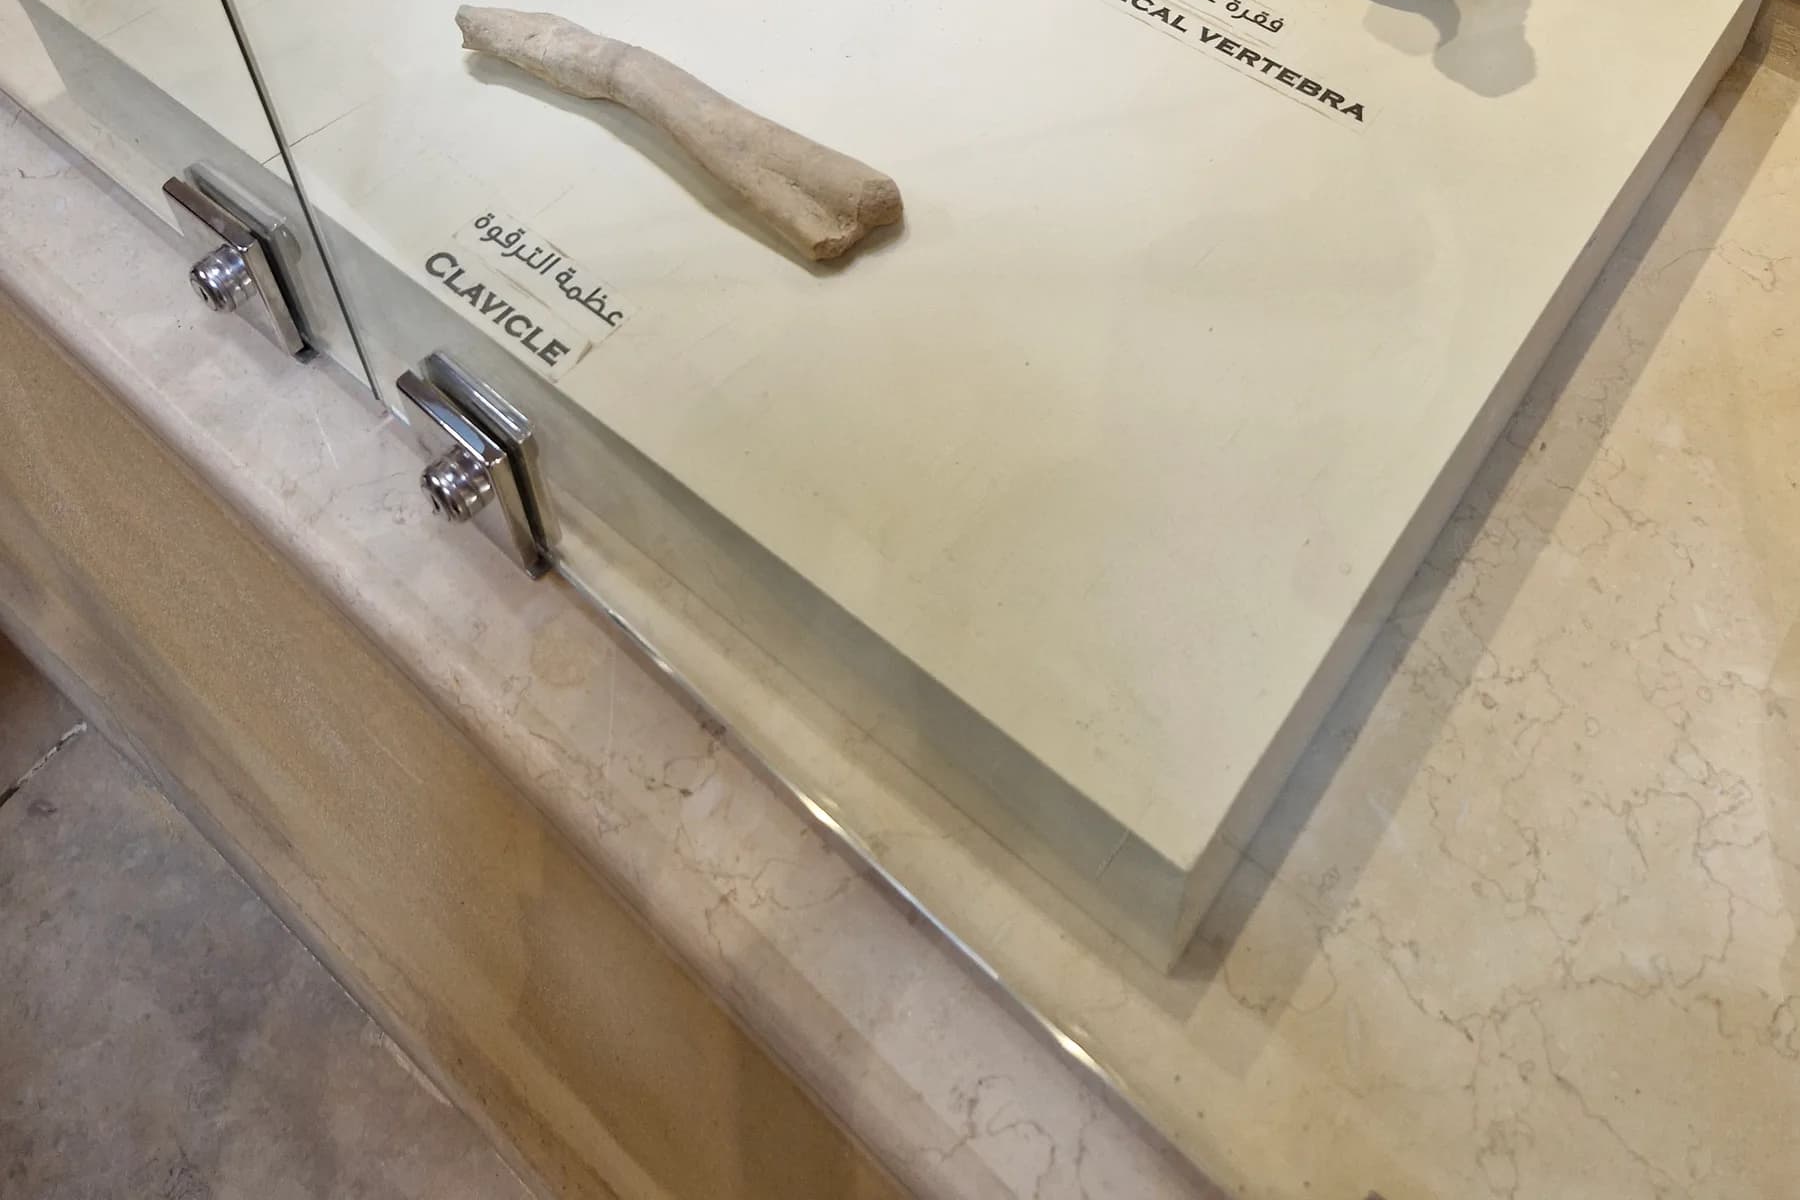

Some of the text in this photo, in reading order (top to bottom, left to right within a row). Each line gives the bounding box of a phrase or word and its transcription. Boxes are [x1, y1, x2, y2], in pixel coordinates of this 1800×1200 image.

[1199, 26, 1365, 122] VERTEBRA
[425, 251, 571, 367] CLAVICLE
[474, 212, 624, 327] عظمة الترقوة
